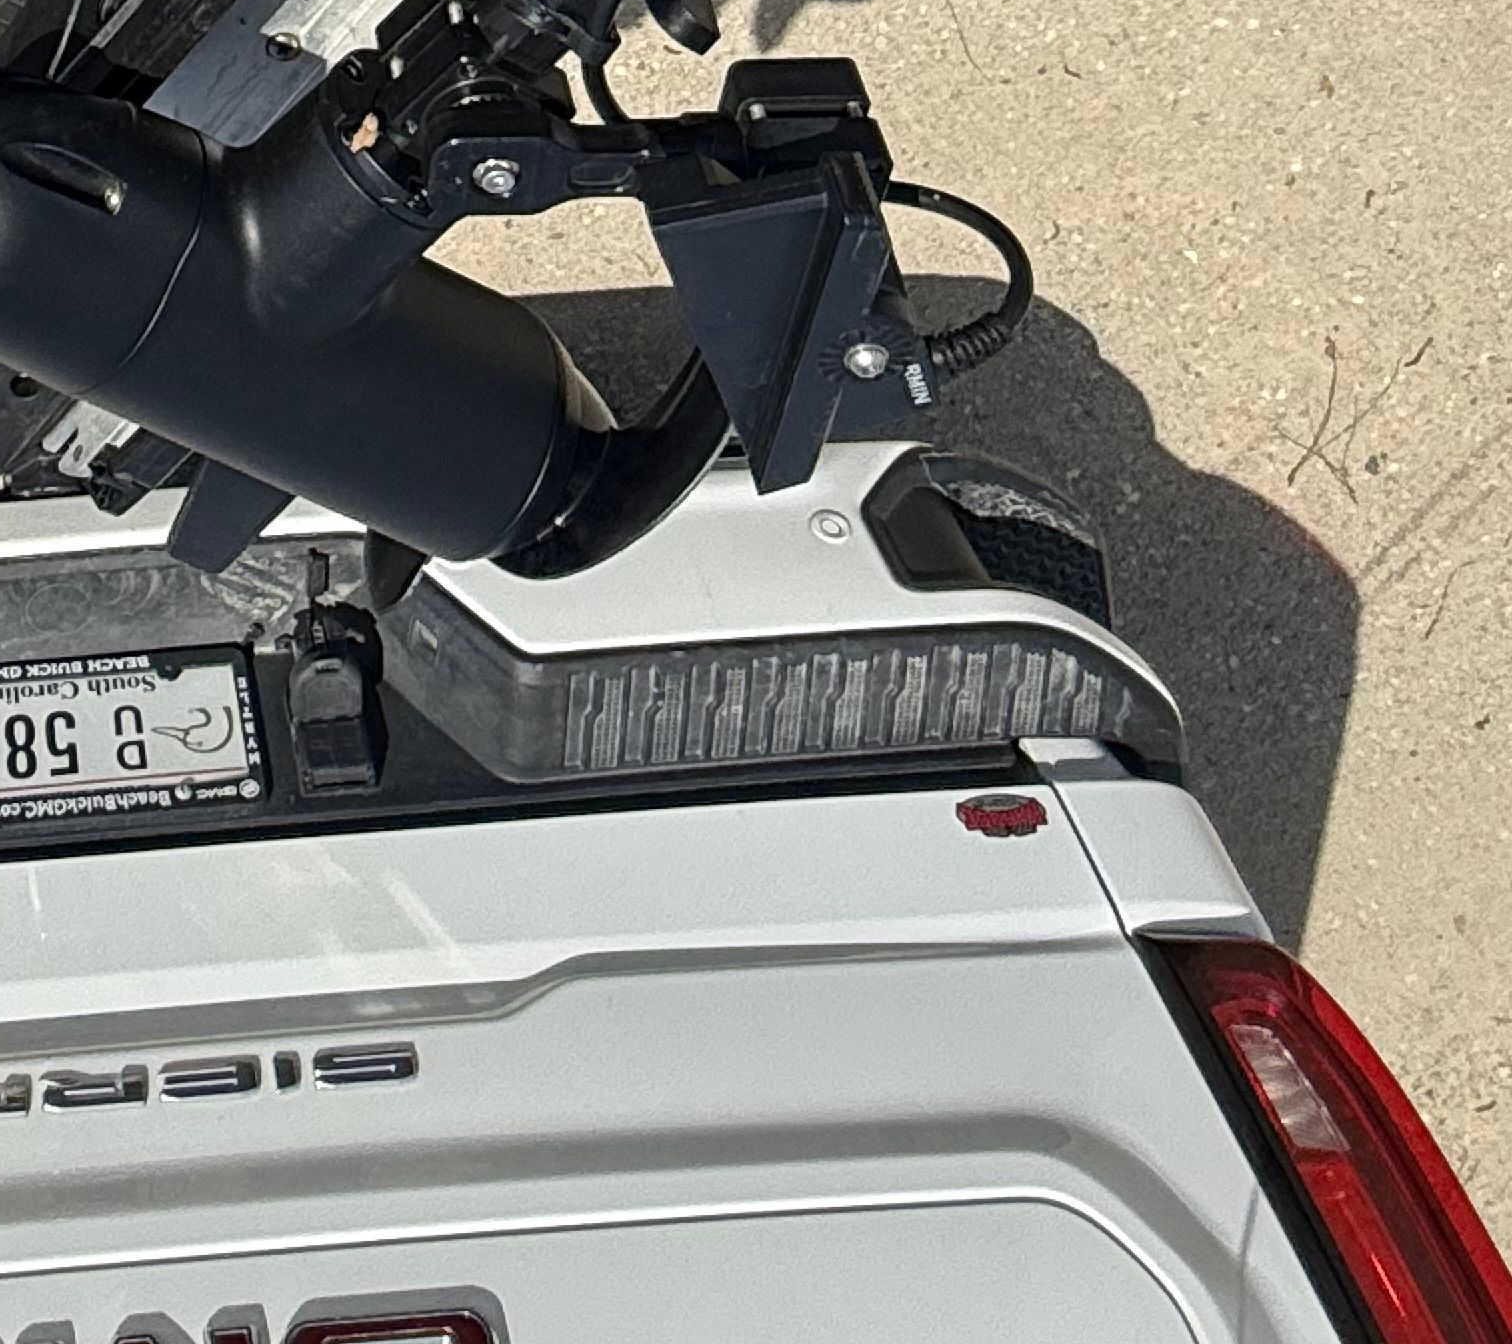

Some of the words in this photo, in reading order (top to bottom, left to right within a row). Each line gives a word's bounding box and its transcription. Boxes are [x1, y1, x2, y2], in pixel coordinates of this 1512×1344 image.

[25, 660, 84, 678] BUICK
[87, 655, 150, 672] BEACH
[88, 675, 156, 696] South
